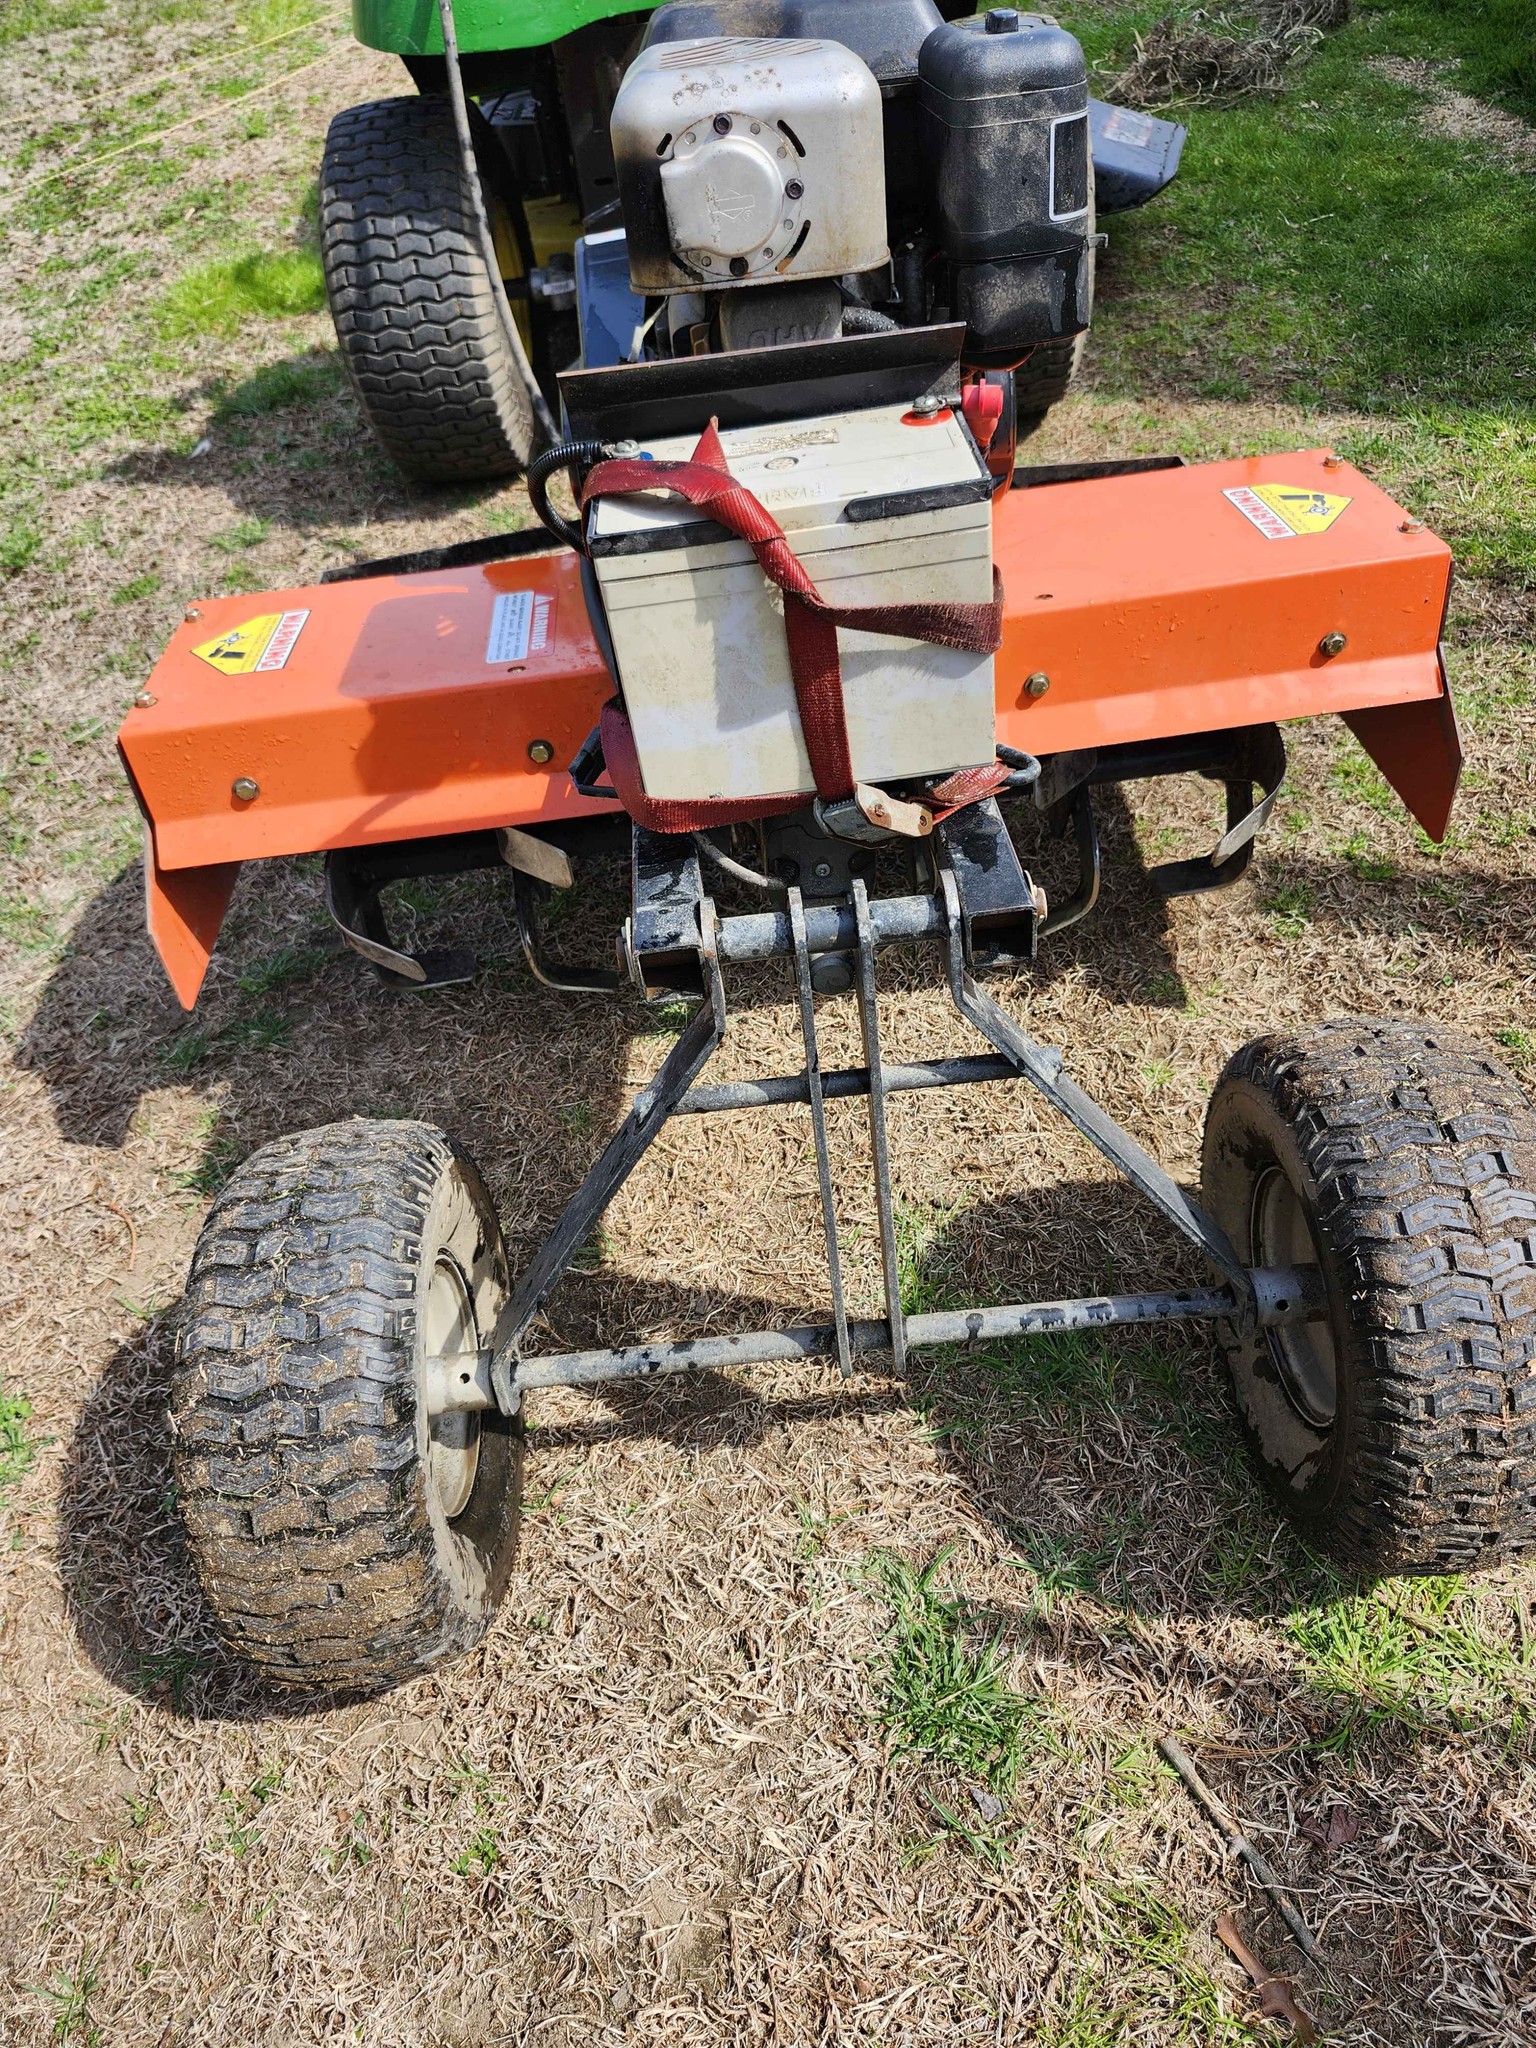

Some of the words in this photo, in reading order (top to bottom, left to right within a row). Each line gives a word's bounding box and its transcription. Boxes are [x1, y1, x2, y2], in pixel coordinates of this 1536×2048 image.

[1229, 489, 1289, 537] WARNING
[260, 613, 305, 669] WARNING
[531, 605, 550, 651] WARNING
